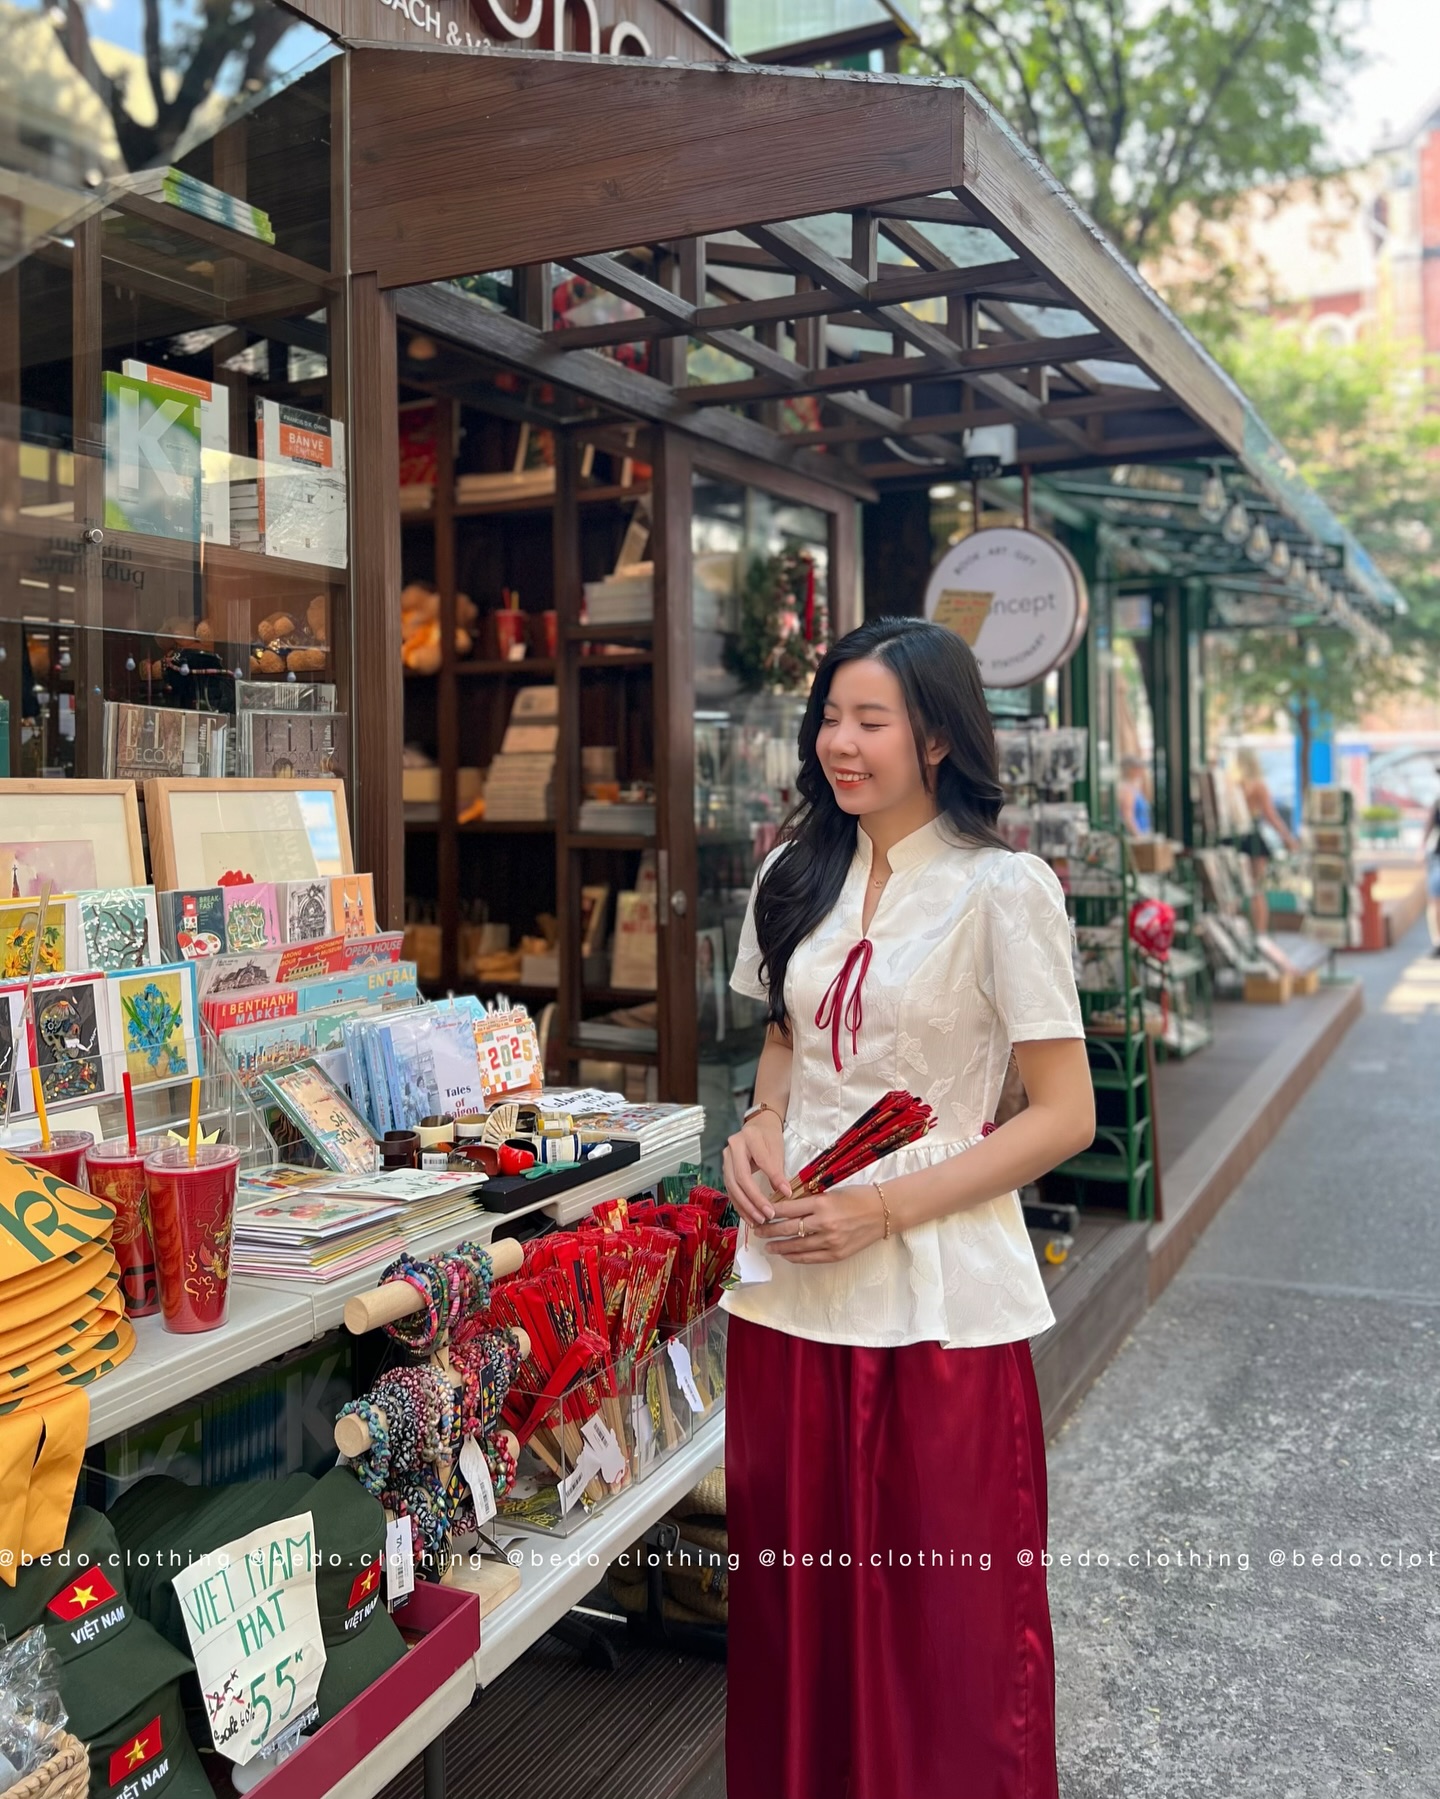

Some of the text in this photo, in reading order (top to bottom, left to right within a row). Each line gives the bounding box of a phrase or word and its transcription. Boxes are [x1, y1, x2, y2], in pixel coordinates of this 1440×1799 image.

[379, 0, 440, 39] ACH
[345, 940, 401, 958] OPERA HOUSE
[368, 967, 415, 990] ENTRAL
[230, 992, 294, 1016] BENTHANH
[235, 1004, 289, 1026] MARKET
[487, 1036, 533, 1071] 2025
[444, 1085, 472, 1098] Tales
[455, 1098, 465, 1108] of
[245, 1531, 312, 1598] NAM
[70, 1605, 126, 1645] VIỆT NAM
[237, 1588, 286, 1657] HAT
[344, 1609, 365, 1630] VIỆT
[140, 1758, 170, 1792] NAM
